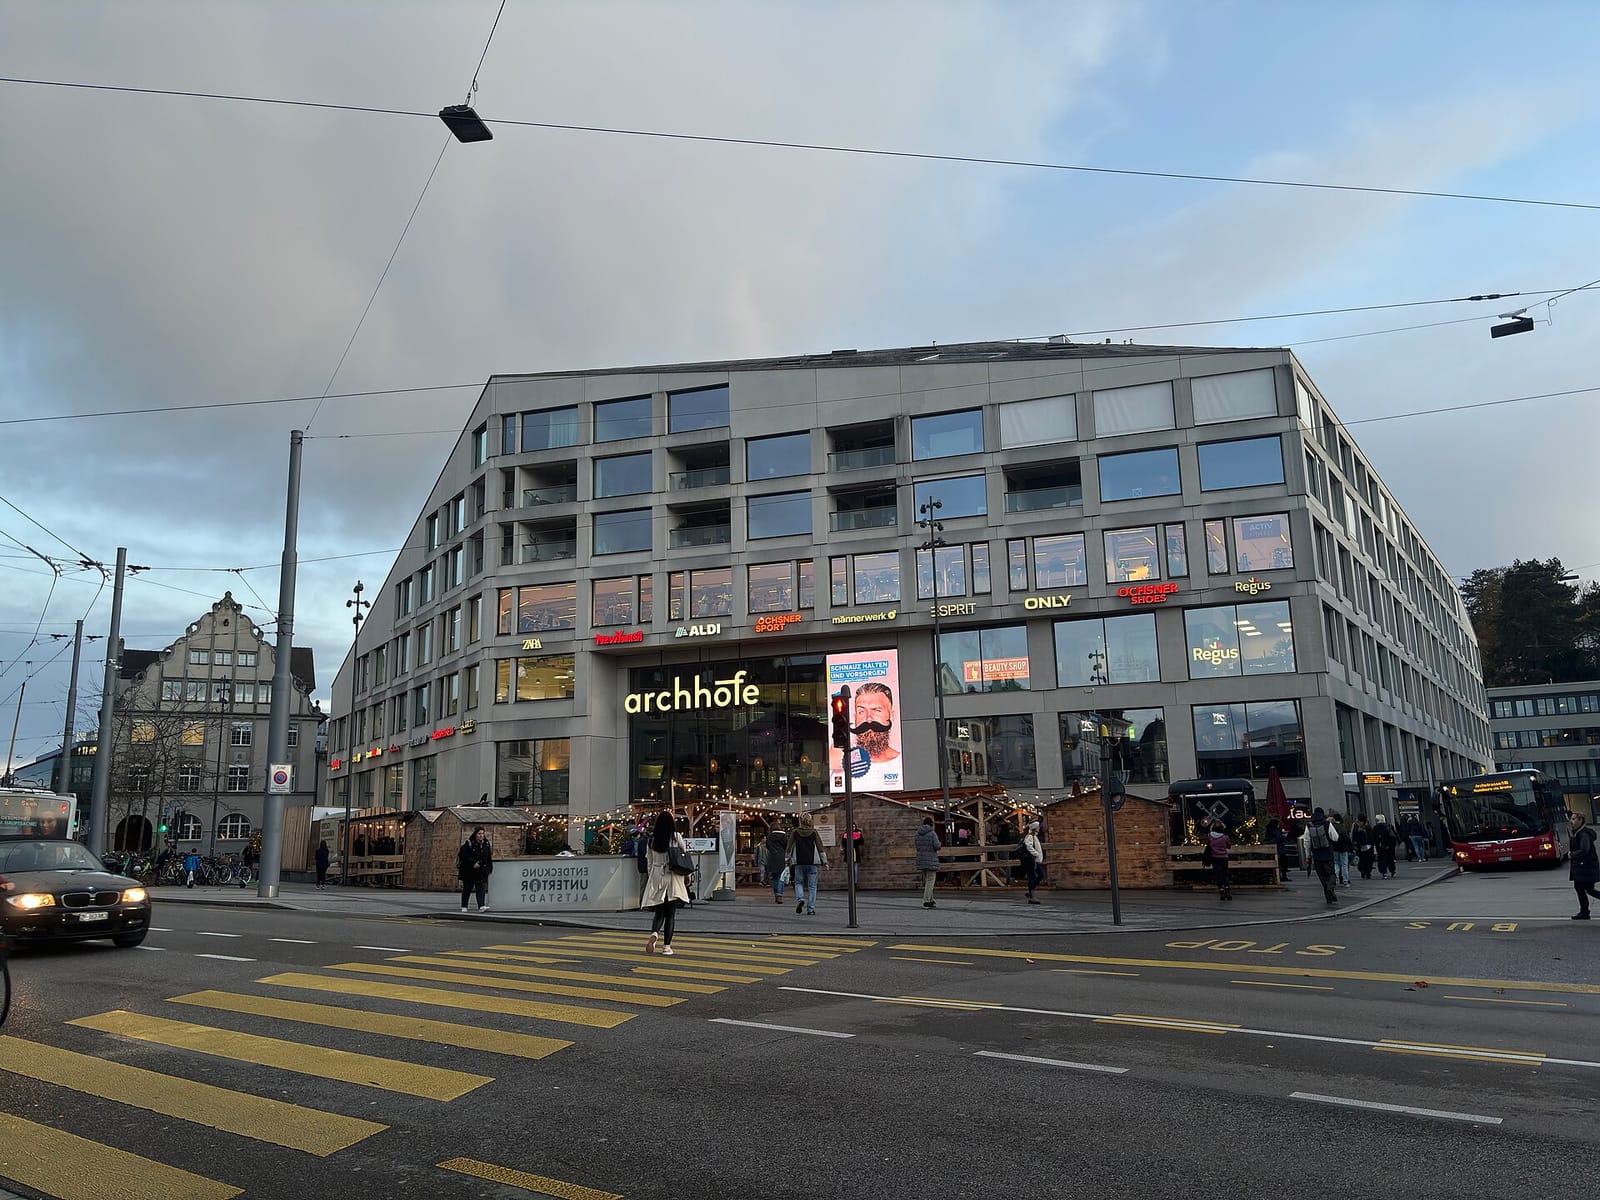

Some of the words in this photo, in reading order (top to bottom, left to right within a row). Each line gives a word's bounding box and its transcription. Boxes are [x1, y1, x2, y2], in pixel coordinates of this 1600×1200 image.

[1249, 522, 1273, 531] ACTIV
[1117, 582, 1179, 598] OCHSNER
[1235, 579, 1271, 595] Regus
[1024, 594, 1072, 610] ONLY
[1130, 593, 1167, 605] SHOES
[758, 614, 801, 625] OCHSNER
[689, 623, 721, 637] ALDI
[755, 623, 785, 633] SPORT
[1193, 646, 1239, 665] Regus
[831, 663, 861, 671] SCHNAUZ
[862, 661, 888, 670] HALTEN
[984, 663, 1007, 672] BEAUTY
[1008, 661, 1026, 671] SHOP
[845, 670, 886, 678] VORSORGEN
[1450, 786, 1457, 796] 4
[1404, 921, 1519, 933] BUS
[1164, 939, 1346, 956] STOP
